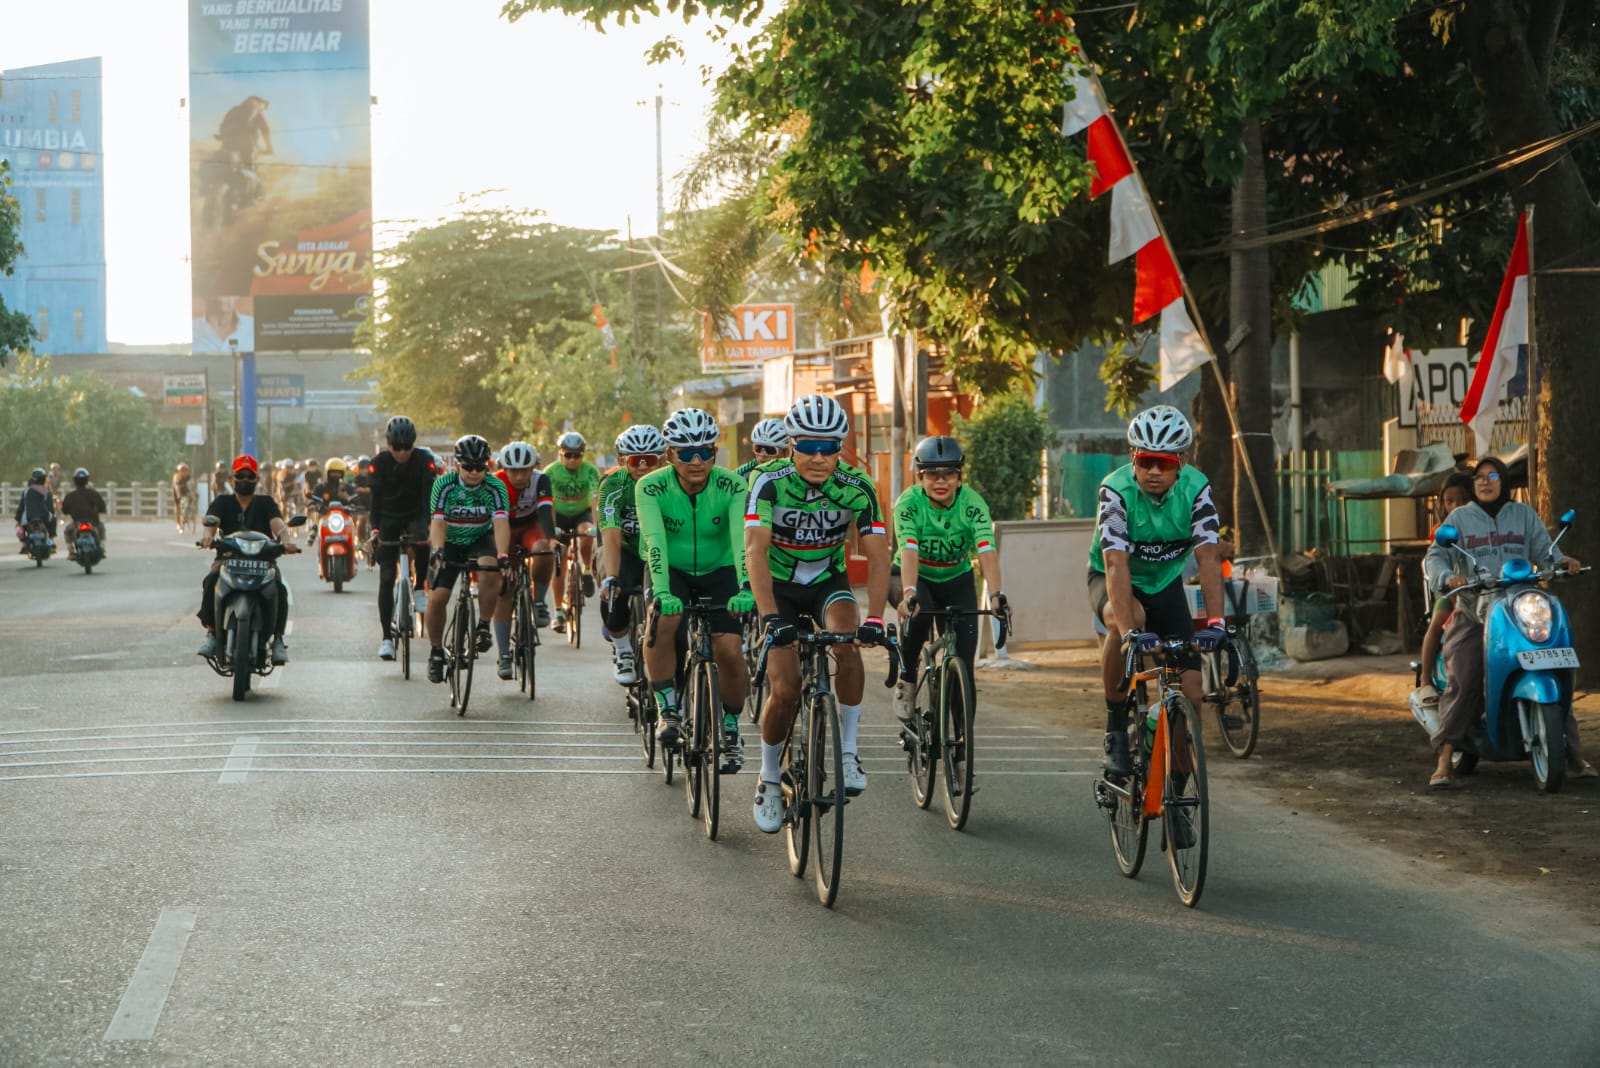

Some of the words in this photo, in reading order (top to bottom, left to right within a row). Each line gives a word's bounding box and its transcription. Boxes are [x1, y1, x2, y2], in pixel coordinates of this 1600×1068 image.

[236, 0, 342, 15] BERKUALITAS
[219, 18, 250, 30] YANG
[254, 18, 290, 30] PASTI
[234, 31, 342, 53] BERSINAR
[253, 241, 359, 290] Surya
[782, 510, 841, 529] GFNY
[795, 529, 826, 541] BALI
